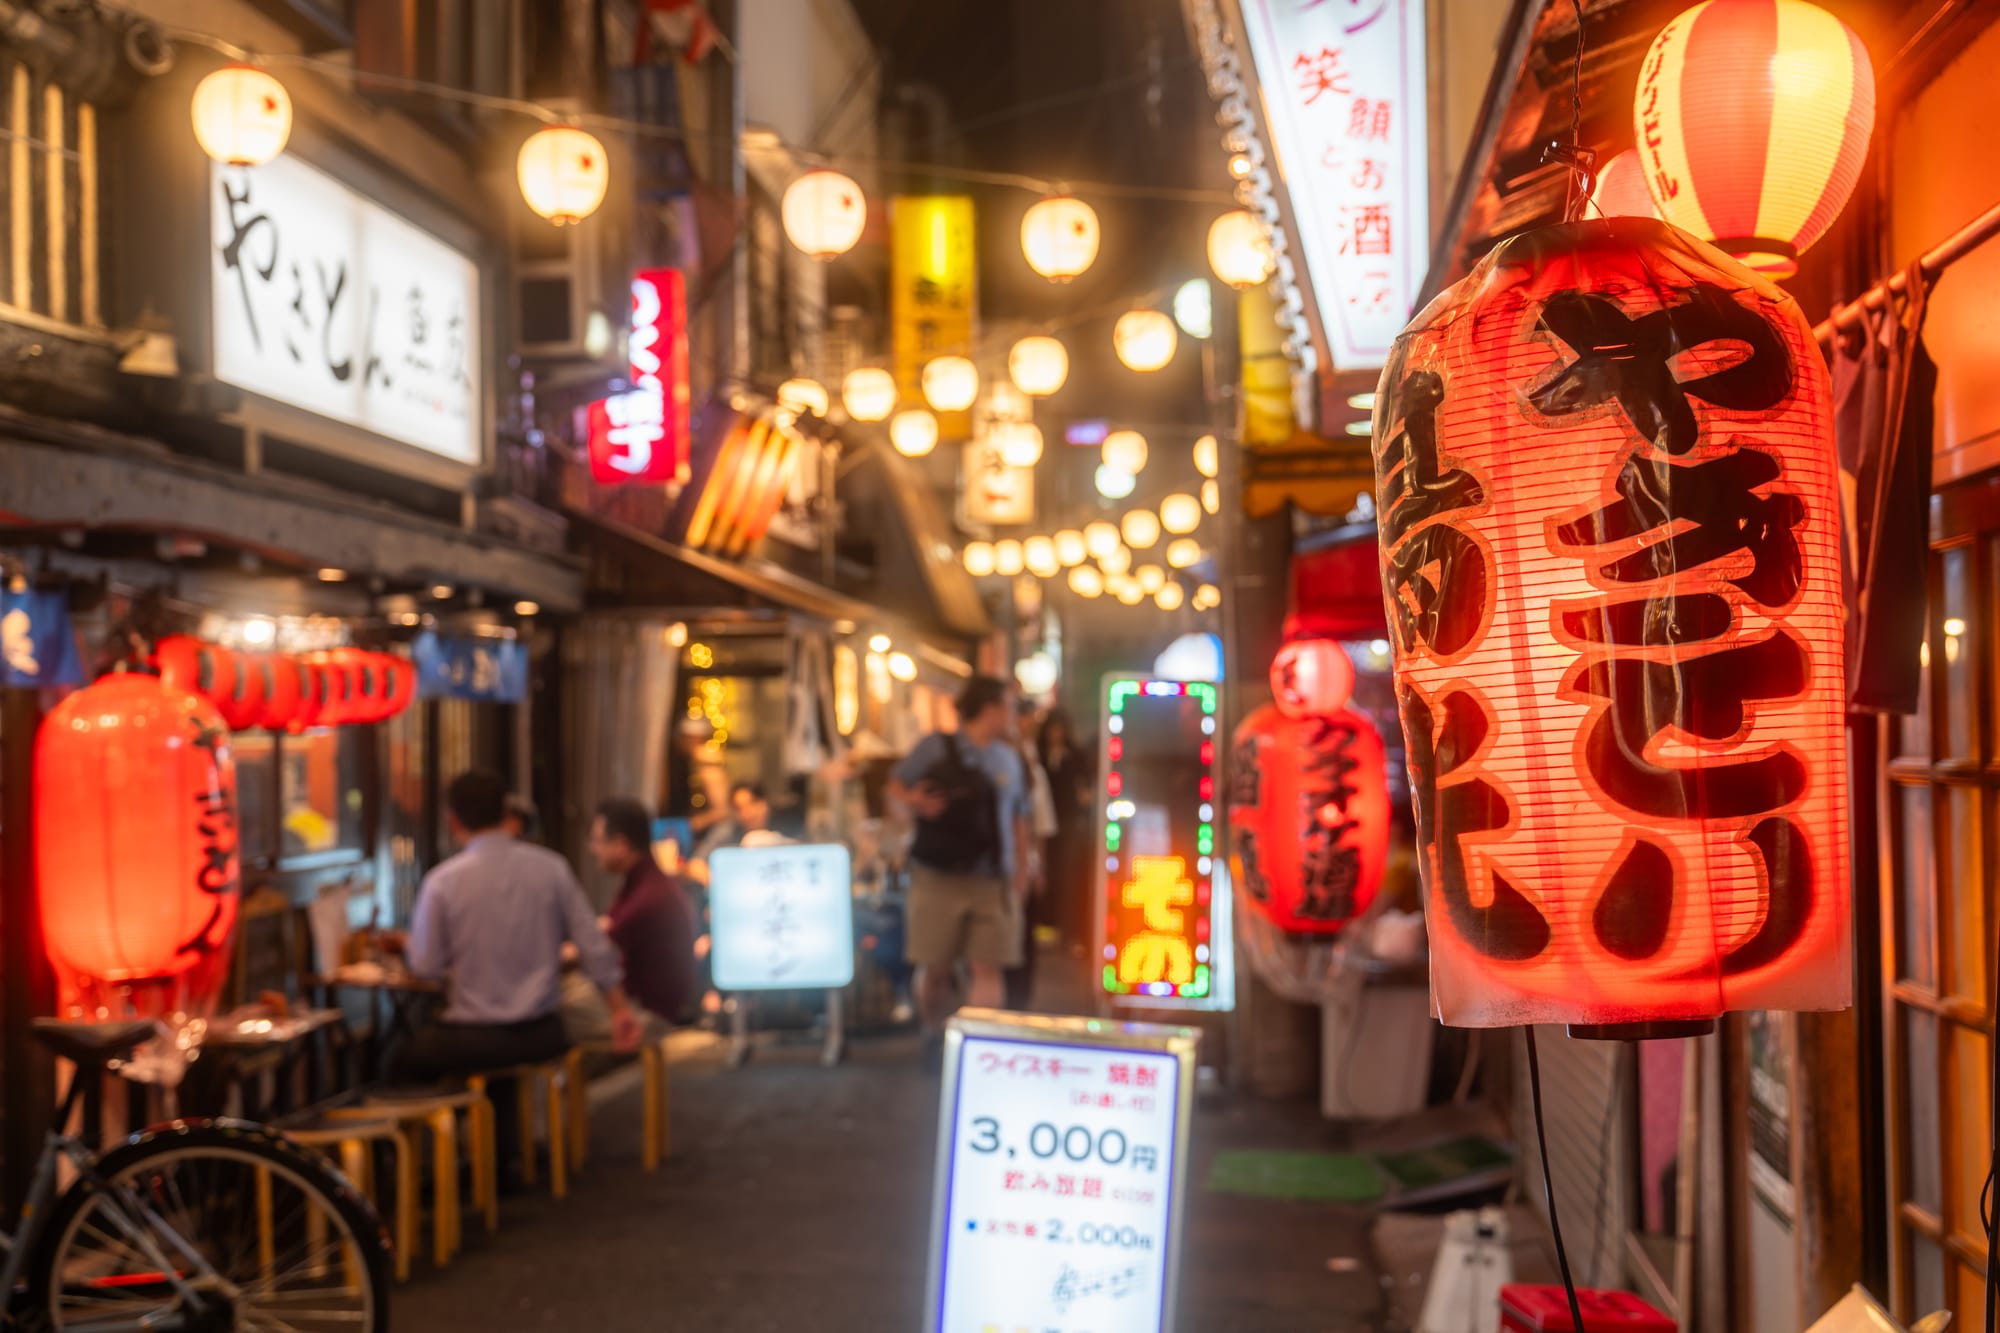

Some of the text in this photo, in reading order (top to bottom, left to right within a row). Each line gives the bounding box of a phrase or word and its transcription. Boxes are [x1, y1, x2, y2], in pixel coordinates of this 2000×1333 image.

[1527, 292, 1813, 978] やきとり
[977, 1052, 1093, 1079] ウイスキー
